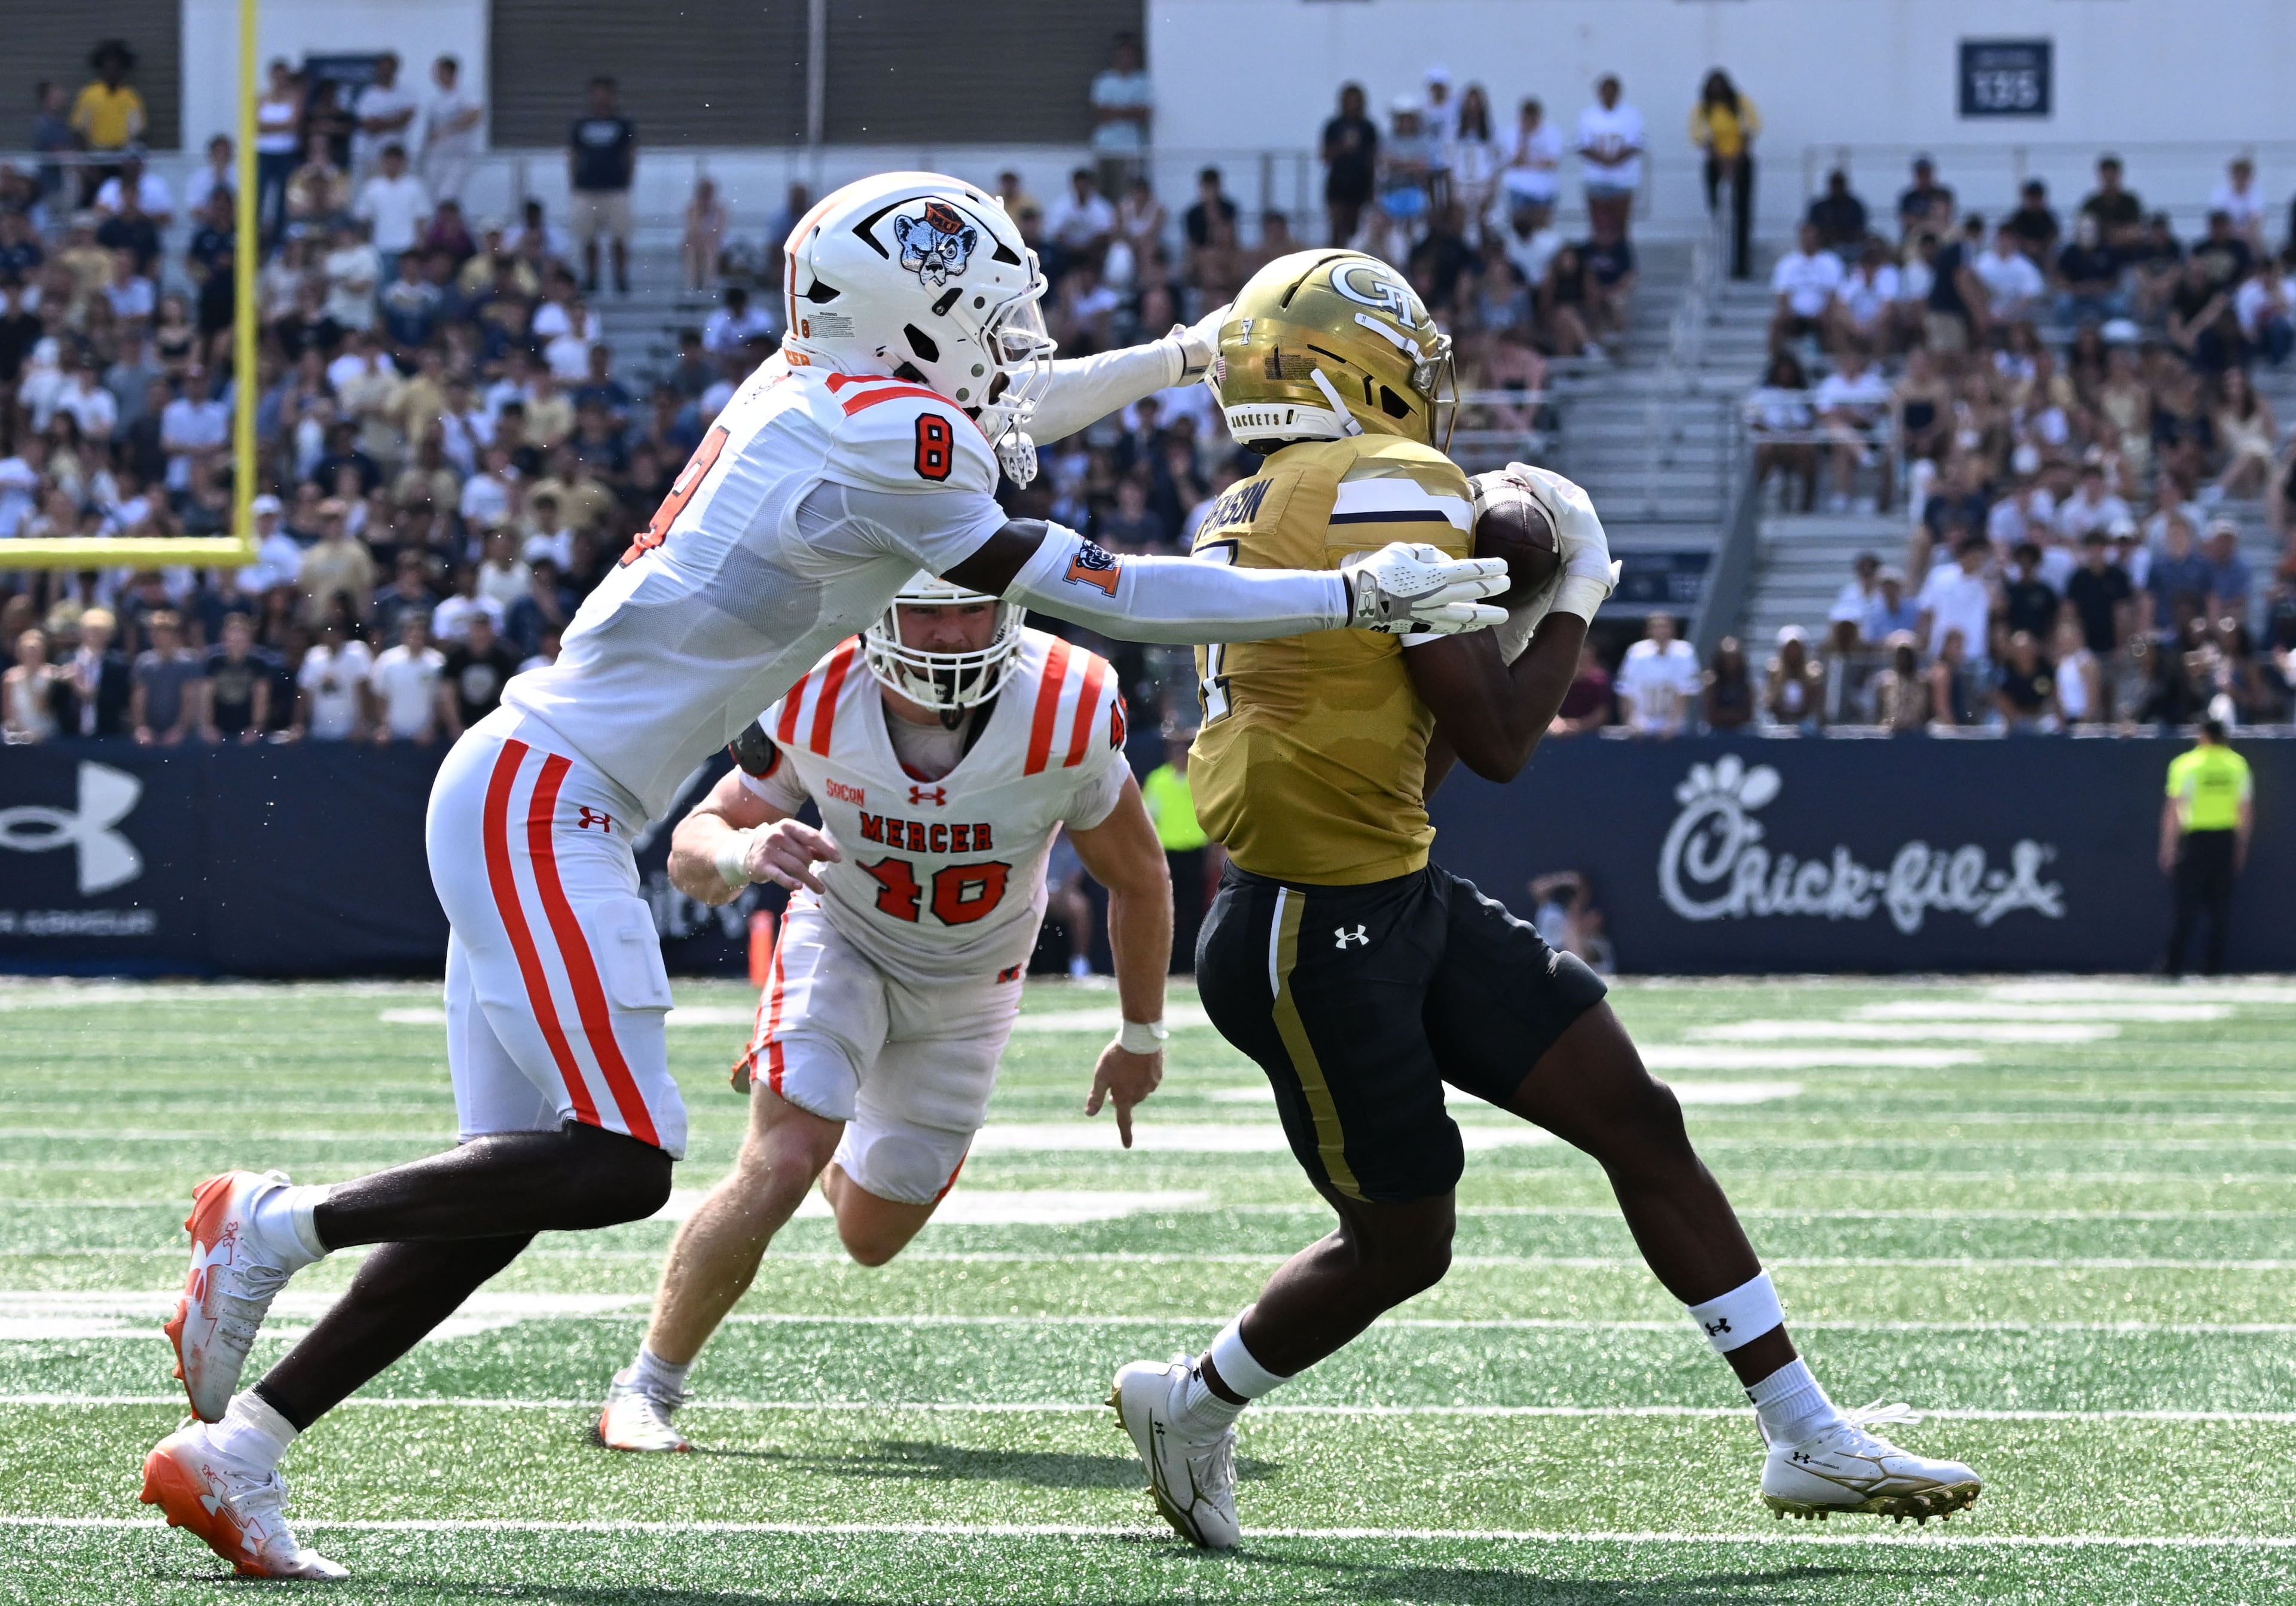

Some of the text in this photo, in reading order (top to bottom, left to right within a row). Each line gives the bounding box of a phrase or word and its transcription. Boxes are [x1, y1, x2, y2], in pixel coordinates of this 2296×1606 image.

[801, 318, 810, 339] 8
[1239, 317, 1255, 346] 7
[1231, 413, 1280, 428] JACKETS
[914, 412, 954, 481] 8
[859, 811, 993, 853] MERCER
